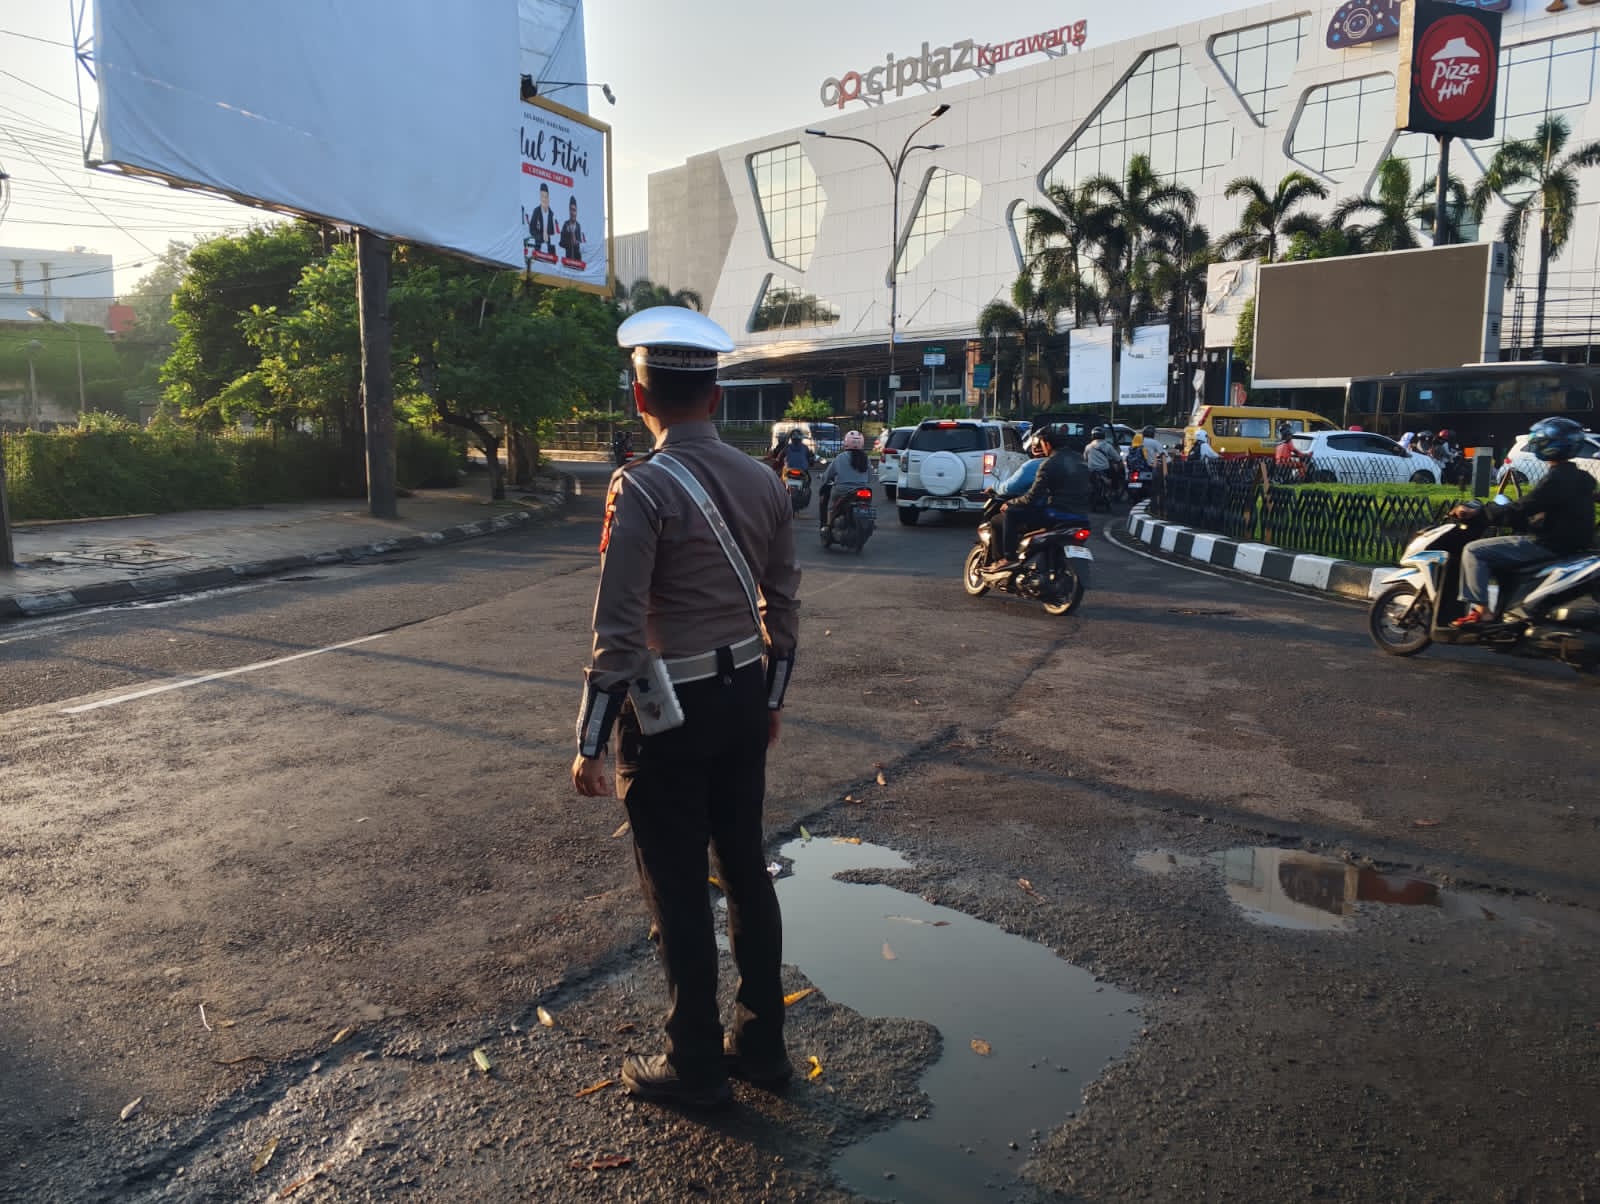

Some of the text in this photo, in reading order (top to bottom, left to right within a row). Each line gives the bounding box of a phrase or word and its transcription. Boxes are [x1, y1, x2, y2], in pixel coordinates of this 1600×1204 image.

[977, 19, 1088, 67] Karawang
[1430, 58, 1481, 89] Pizza
[1437, 78, 1474, 103] Hut
[549, 135, 589, 176] Fitri
